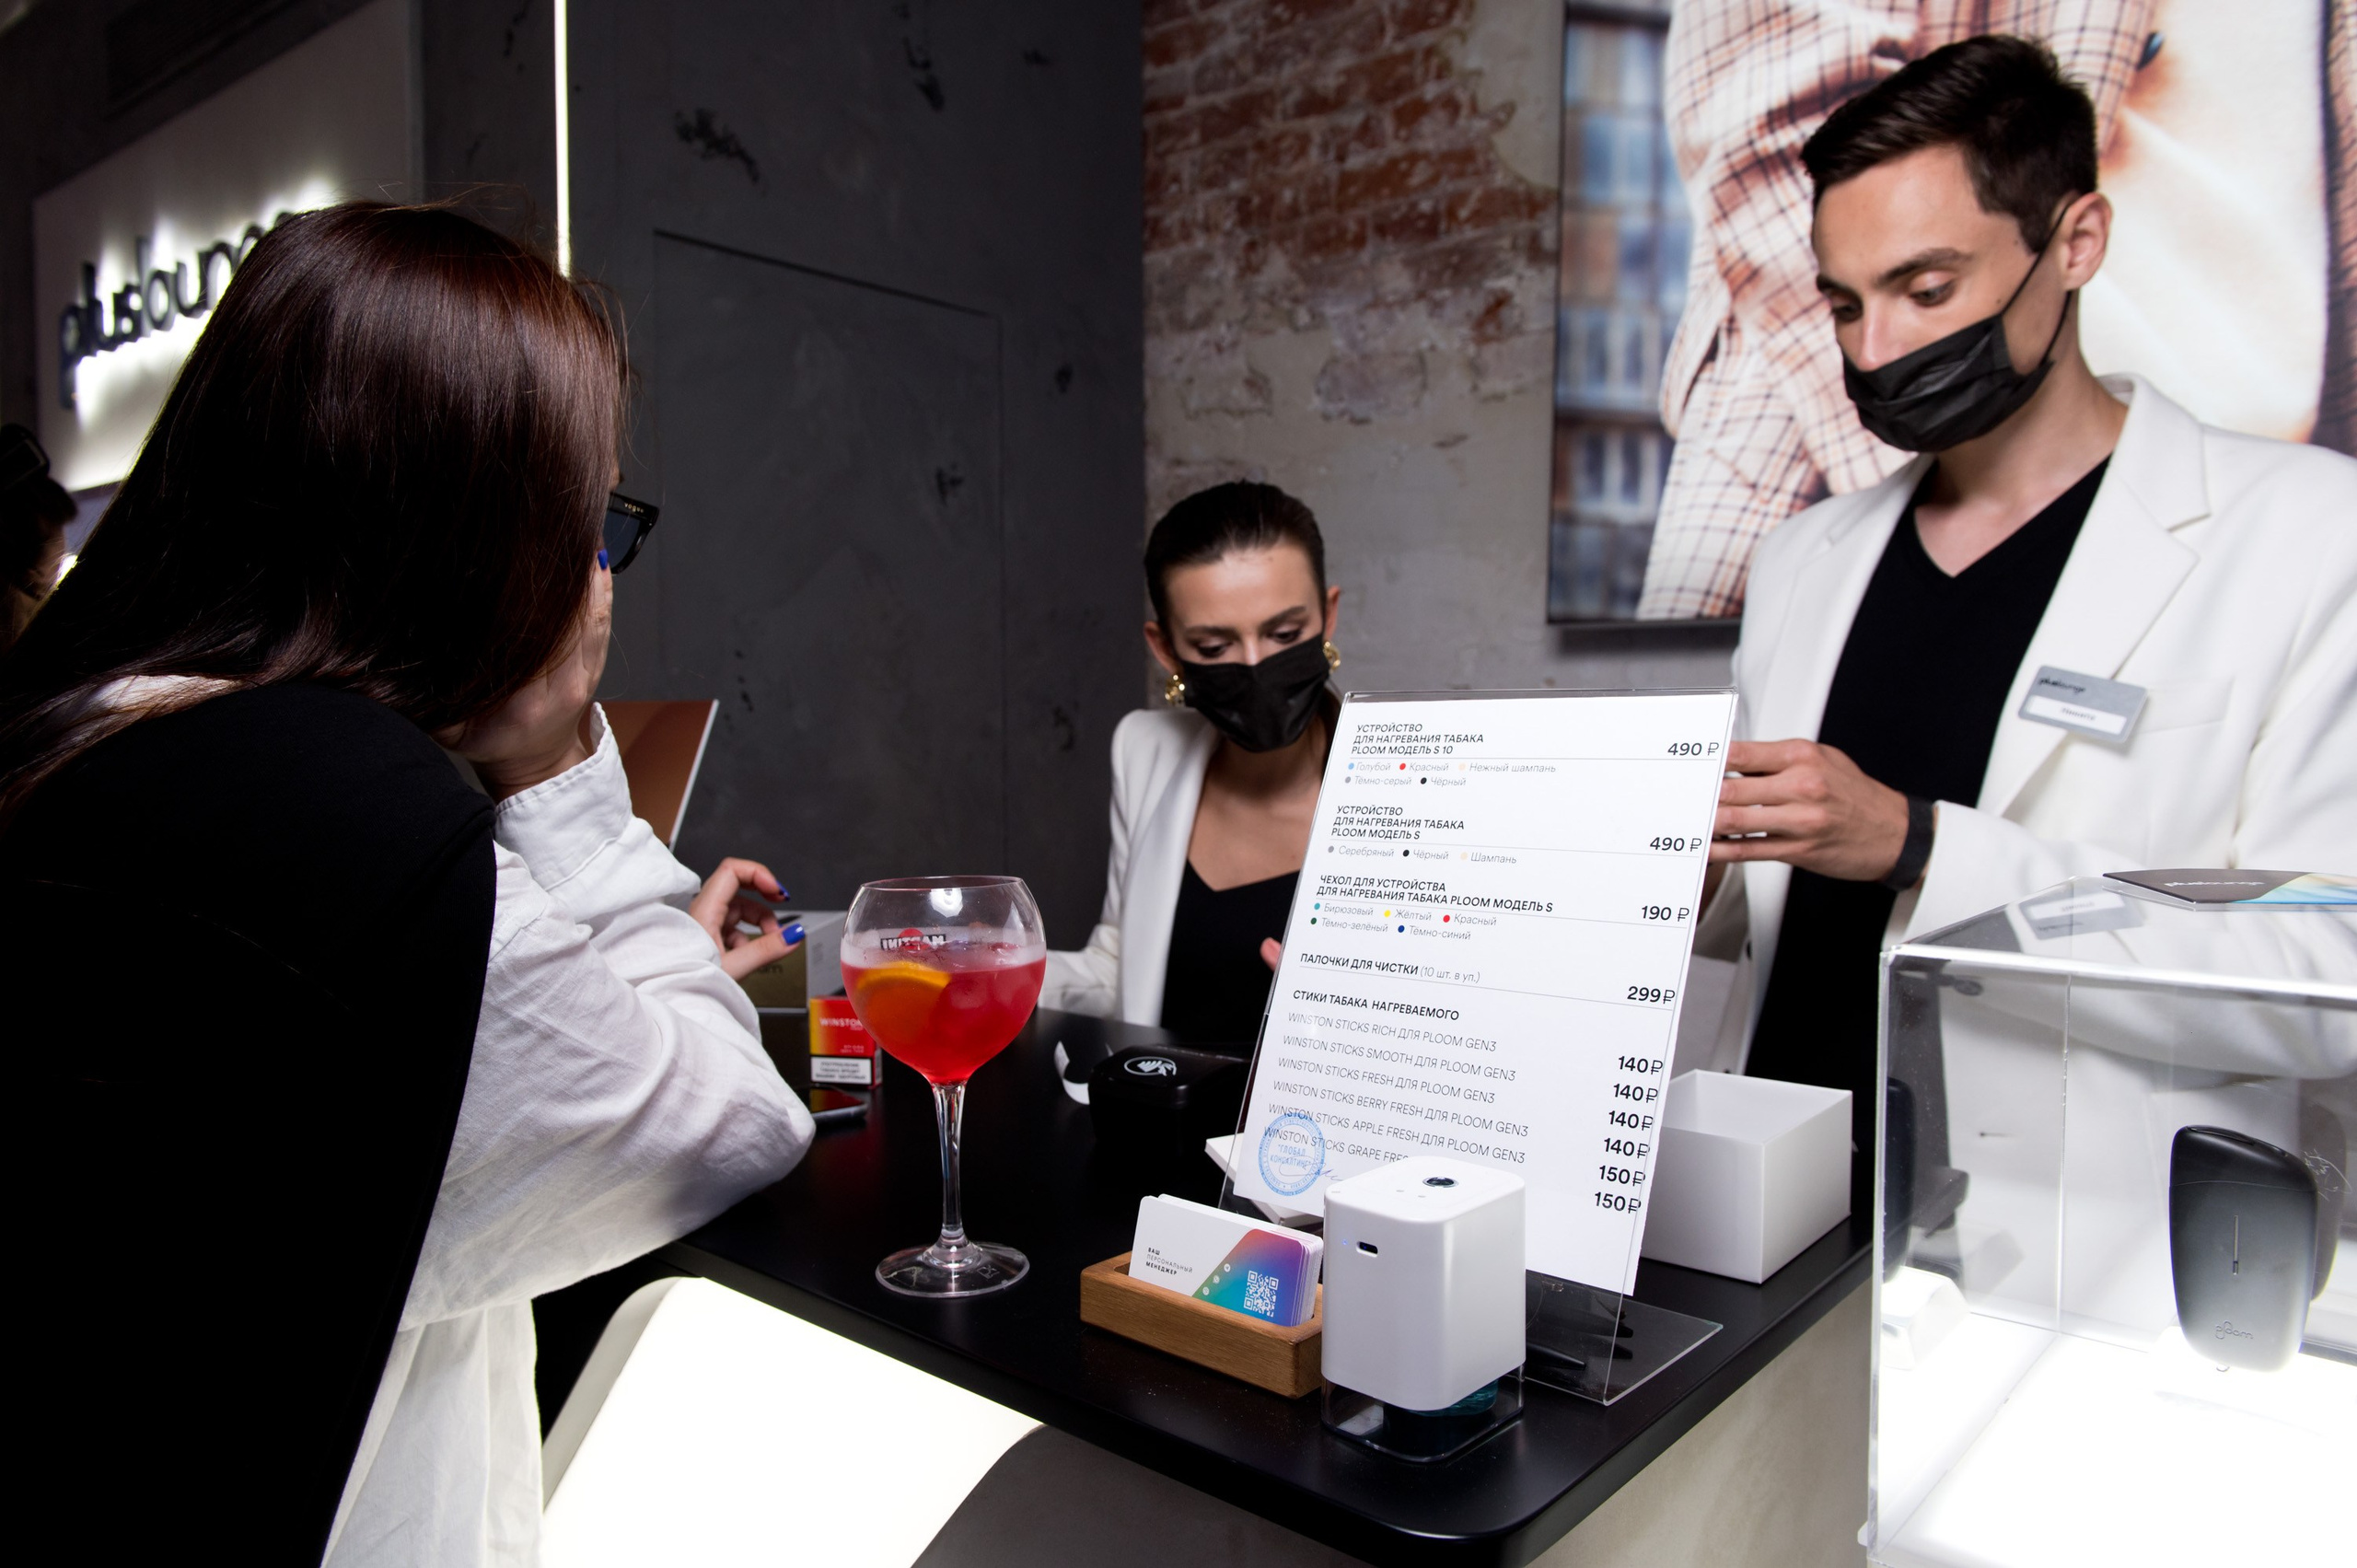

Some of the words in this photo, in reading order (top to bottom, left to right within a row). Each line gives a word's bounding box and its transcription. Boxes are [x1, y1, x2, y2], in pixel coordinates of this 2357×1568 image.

[60, 210, 295, 409] plusloun
[1356, 723, 1422, 733] УСТРОЙСТВО
[1353, 736, 1374, 745] ДЛЯ
[1376, 735, 1441, 744] НАГРЕВАНИЯ
[1444, 734, 1484, 743] ТАБАКА
[1351, 746, 1386, 754] PLOOM
[1387, 746, 1432, 756] МОДЕЛЬ
[1434, 746, 1440, 754] S
[1442, 746, 1453, 754] 10
[1356, 762, 1391, 772] Голубой
[1409, 762, 1449, 772] Красный
[1469, 763, 1509, 772] Нежный
[1511, 765, 1556, 773] шампань
[1431, 777, 1467, 786] Чёрный
[1337, 805, 1403, 816] УСТРОЙСТВО
[1333, 817, 1354, 826] ДЛЯ
[1356, 818, 1422, 829] НАГРЕВАНИЯ
[1424, 820, 1465, 830] ТАБАКА
[1331, 829, 1365, 837] PLOOM
[1368, 830, 1411, 840] МОДЕЛЬ
[1413, 830, 1421, 840] S
[1339, 845, 1394, 857] Серебряный
[1413, 849, 1449, 860] Чёрный
[1470, 853, 1517, 865] Шампань
[1320, 875, 1353, 887] ЧЕХОЛ
[1353, 877, 1376, 889] ДЛЯ
[1377, 878, 1446, 892] УСТРОЙСТВА
[1317, 886, 1338, 896] ДЛЯ
[1340, 888, 1405, 901] НАГРЕВАНИЯ
[1407, 892, 1448, 904] ТАБАКА
[1450, 896, 1491, 907] PLOOM
[1492, 899, 1543, 912] МОДЕЛЬ
[1546, 902, 1553, 912] S
[1324, 904, 1374, 916] Бирюзовый
[1395, 909, 1432, 921] Жёлтый
[1454, 913, 1497, 926] Красный
[1321, 918, 1388, 933] Тёмно-зелёный
[1409, 925, 1471, 940] Тёмно-синий
[1300, 953, 1350, 967] ПАЛОЧКИ
[1351, 959, 1373, 970] ДЛЯ
[1375, 961, 1419, 975] ЧИСТКИ
[1420, 966, 1434, 977] (10
[1436, 970, 1452, 980] шт.
[1462, 971, 1480, 983] уп.)
[1293, 990, 1328, 1003] СТИКИ
[1329, 994, 1368, 1008] ТАБАКА
[1372, 1000, 1459, 1020] НАГРЕВАЕМОГО
[1288, 1012, 1333, 1028] WINSTON
[1335, 1018, 1370, 1033] STICKS
[1371, 1024, 1397, 1037] RICH
[1398, 1028, 1421, 1040] ДЛЯ
[1422, 1031, 1463, 1047] PLOOM
[1465, 1038, 1497, 1051] GEN3
[1283, 1035, 1329, 1051] WINSTON
[1329, 1042, 1364, 1057] STICKS
[1366, 1048, 1413, 1064] SMOOTH
[1414, 1055, 1437, 1068] ДЛЯ
[1440, 1059, 1481, 1075] PLOOM
[1483, 1066, 1516, 1081] GEN3
[1278, 1058, 1323, 1074] WINSTON
[1325, 1065, 1359, 1080] STICKS
[1362, 1072, 1394, 1086] FRESH
[1395, 1077, 1418, 1090] ДЛЯ
[1421, 1081, 1461, 1098] PLOOM
[1463, 1088, 1495, 1103] GEN3
[1273, 1080, 1318, 1098] WINSTON
[1320, 1089, 1355, 1104] STICKS
[1356, 1096, 1388, 1109] BERRY
[1389, 1101, 1423, 1117] FRESH
[1424, 1109, 1448, 1121] ДЛЯ
[1451, 1112, 1492, 1131] PLOOM
[1495, 1121, 1528, 1137] GEN3
[1269, 1103, 1314, 1121] WINSTON
[1316, 1112, 1350, 1128] STICKS
[1353, 1121, 1384, 1135] APPLE
[1386, 1126, 1420, 1143] FRESH
[1421, 1133, 1445, 1147] ДЛЯ
[1447, 1138, 1490, 1156] PLOOM
[1492, 1147, 1526, 1164] GEN3
[1264, 1126, 1309, 1144] WINSTON
[1311, 1136, 1345, 1153] STICKS
[1347, 1144, 1381, 1160] GRAPE
[1383, 1151, 1409, 1163] FRE
[1147, 1247, 1160, 1256] ВАШ
[1145, 1261, 1178, 1275] МЕНЕДЖЕР
[1146, 1253, 1193, 1273] ПЕРСОНАЛЬНЫЙ
